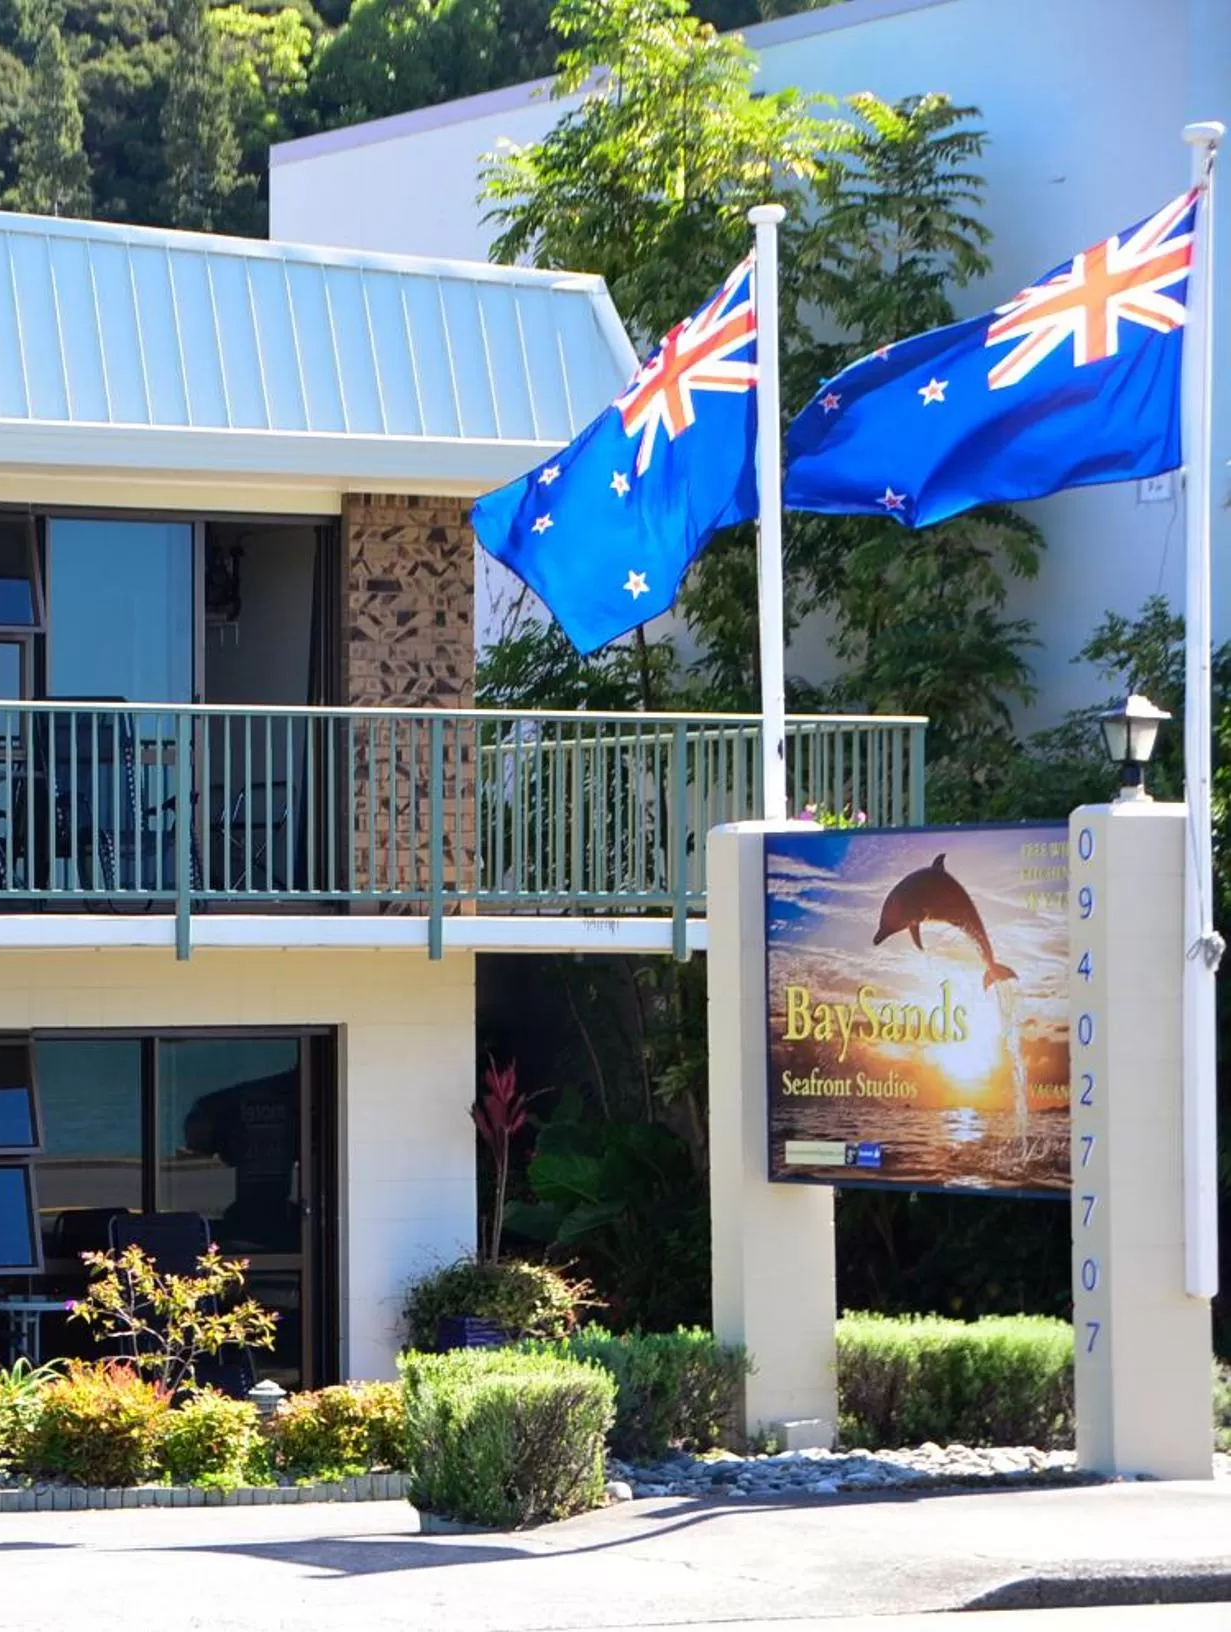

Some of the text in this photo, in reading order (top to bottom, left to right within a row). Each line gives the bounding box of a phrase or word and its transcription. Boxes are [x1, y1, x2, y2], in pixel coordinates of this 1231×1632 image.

[782, 979, 968, 1064] BaySands
[782, 1068, 918, 1098] Seafront Studios
